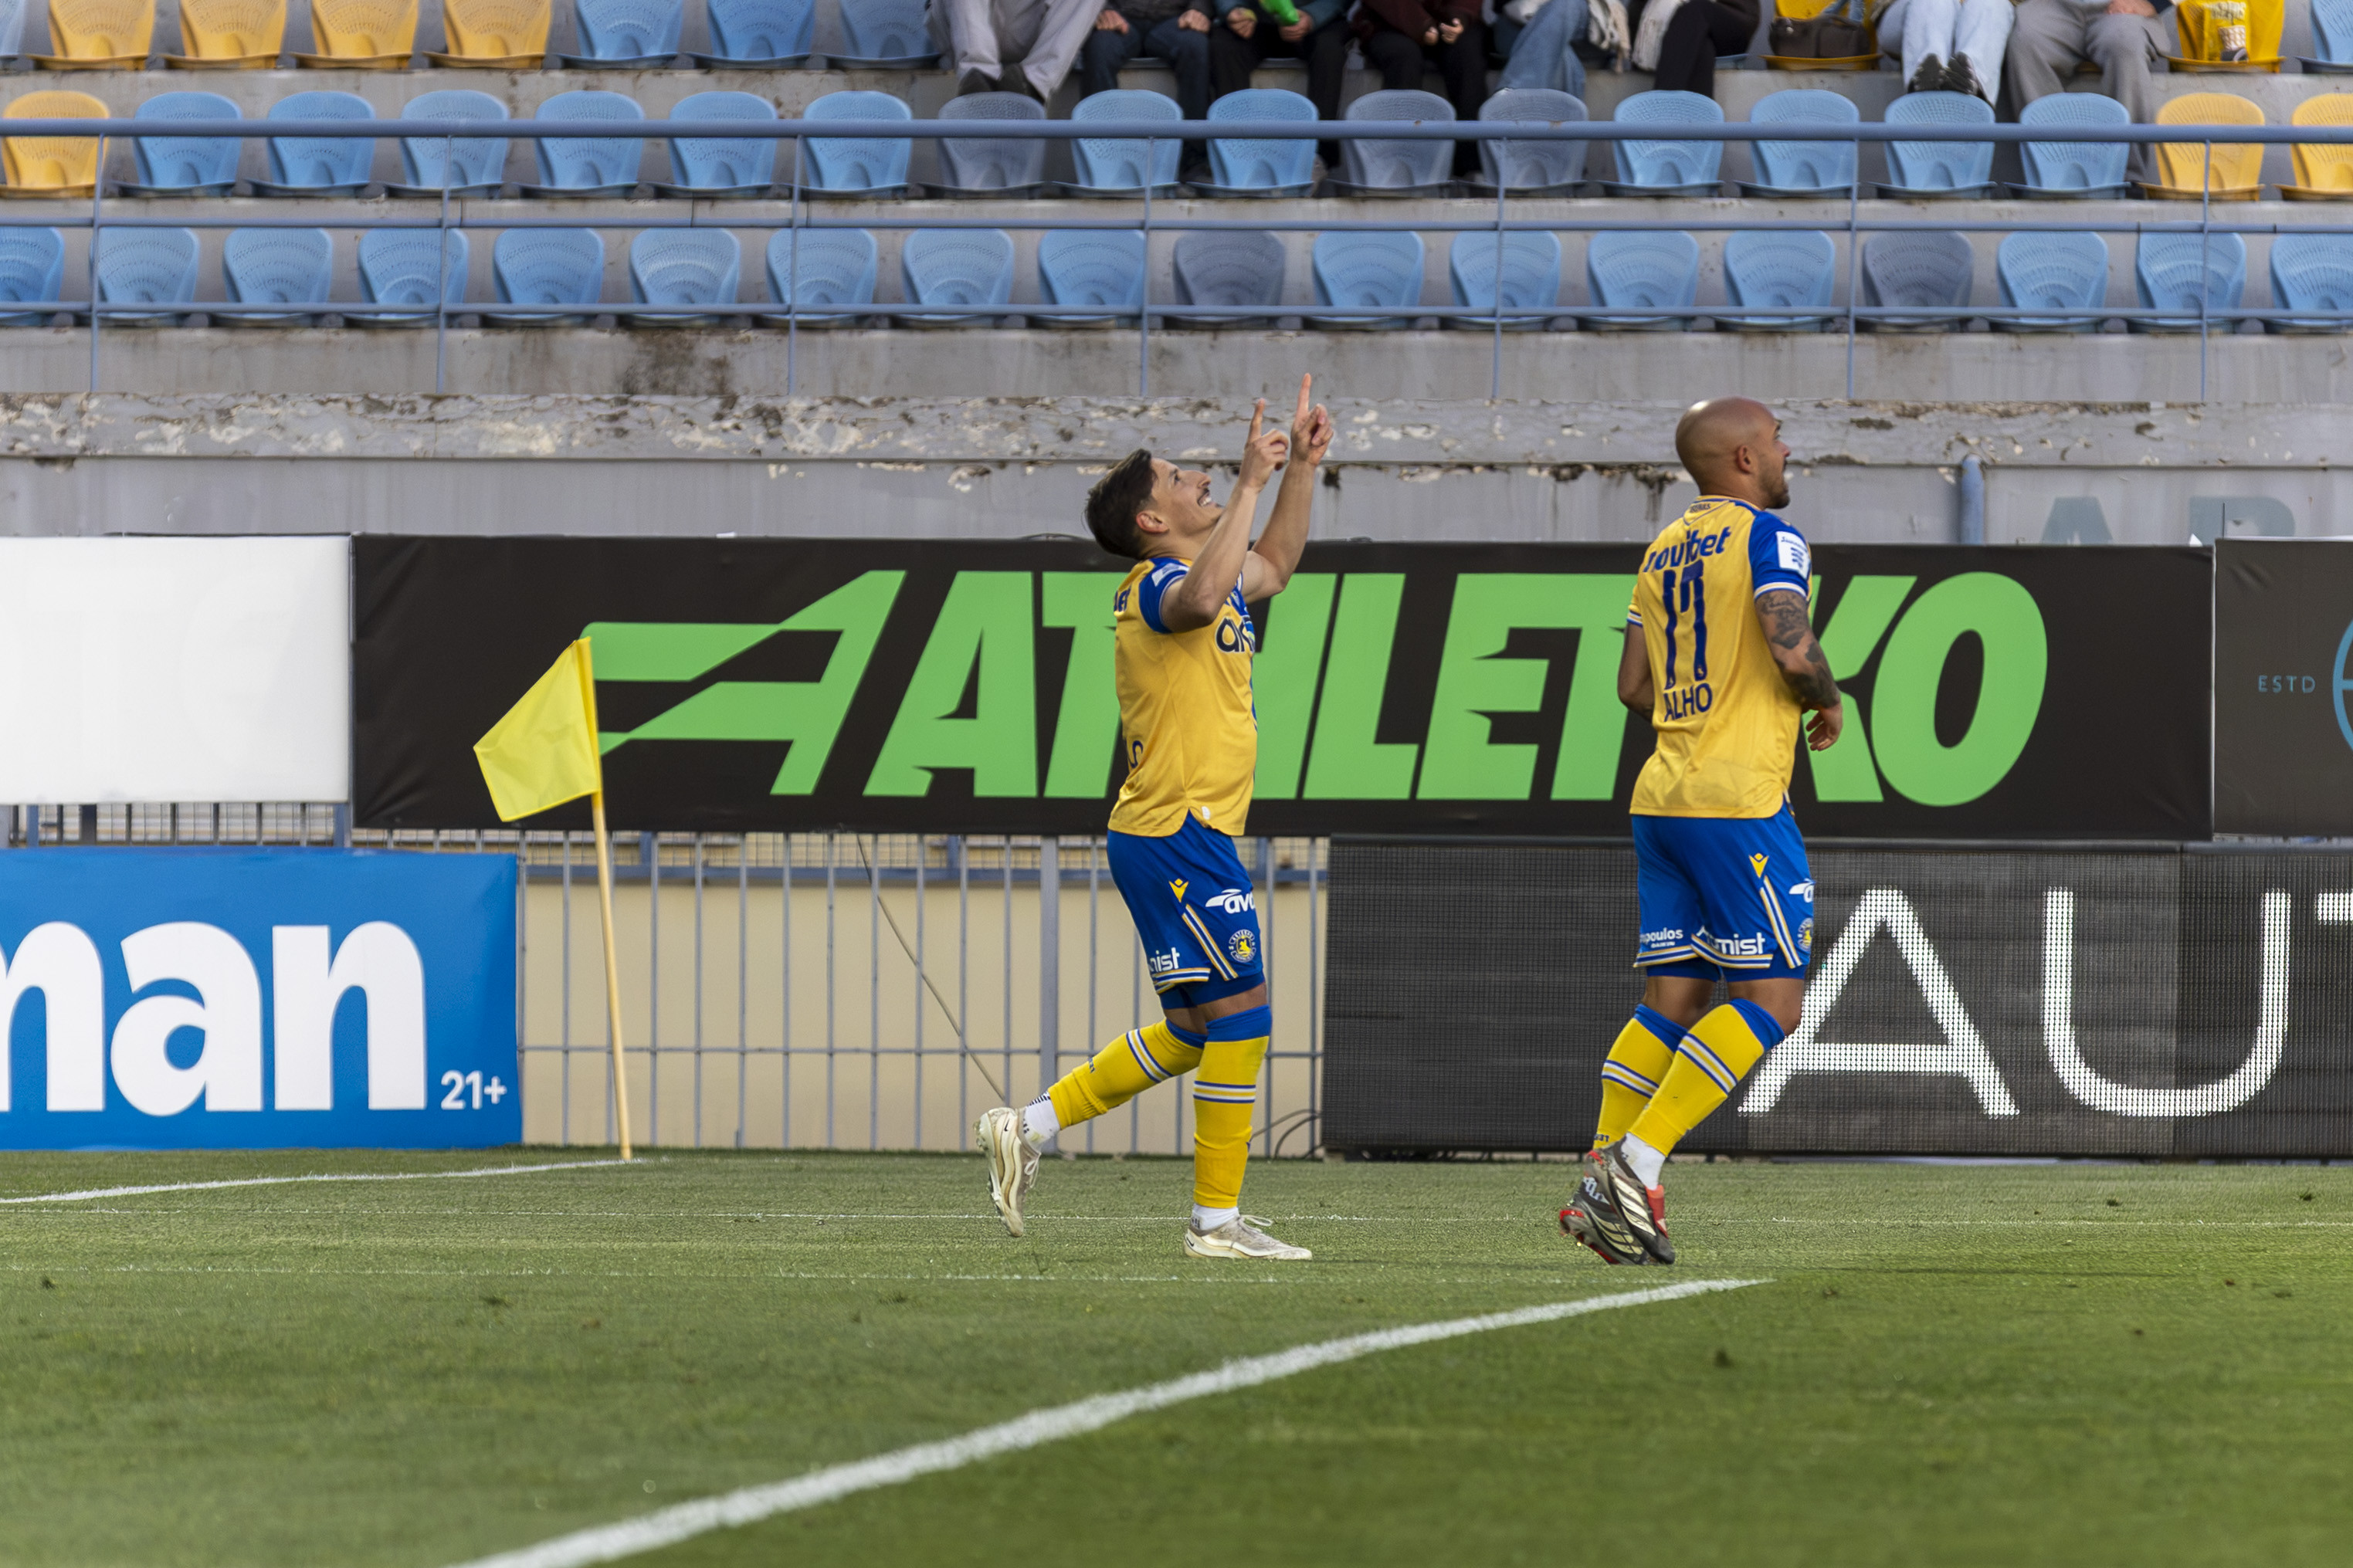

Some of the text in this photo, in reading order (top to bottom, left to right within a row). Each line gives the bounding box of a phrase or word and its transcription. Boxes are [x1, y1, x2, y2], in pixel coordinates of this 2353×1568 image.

[863, 571, 2047, 806] ATLETKO
[1663, 683, 1713, 722] ALHO
[2258, 675, 2316, 693] ESTD
[1738, 886, 2353, 1117] AU
[441, 1070, 507, 1109] 21+
